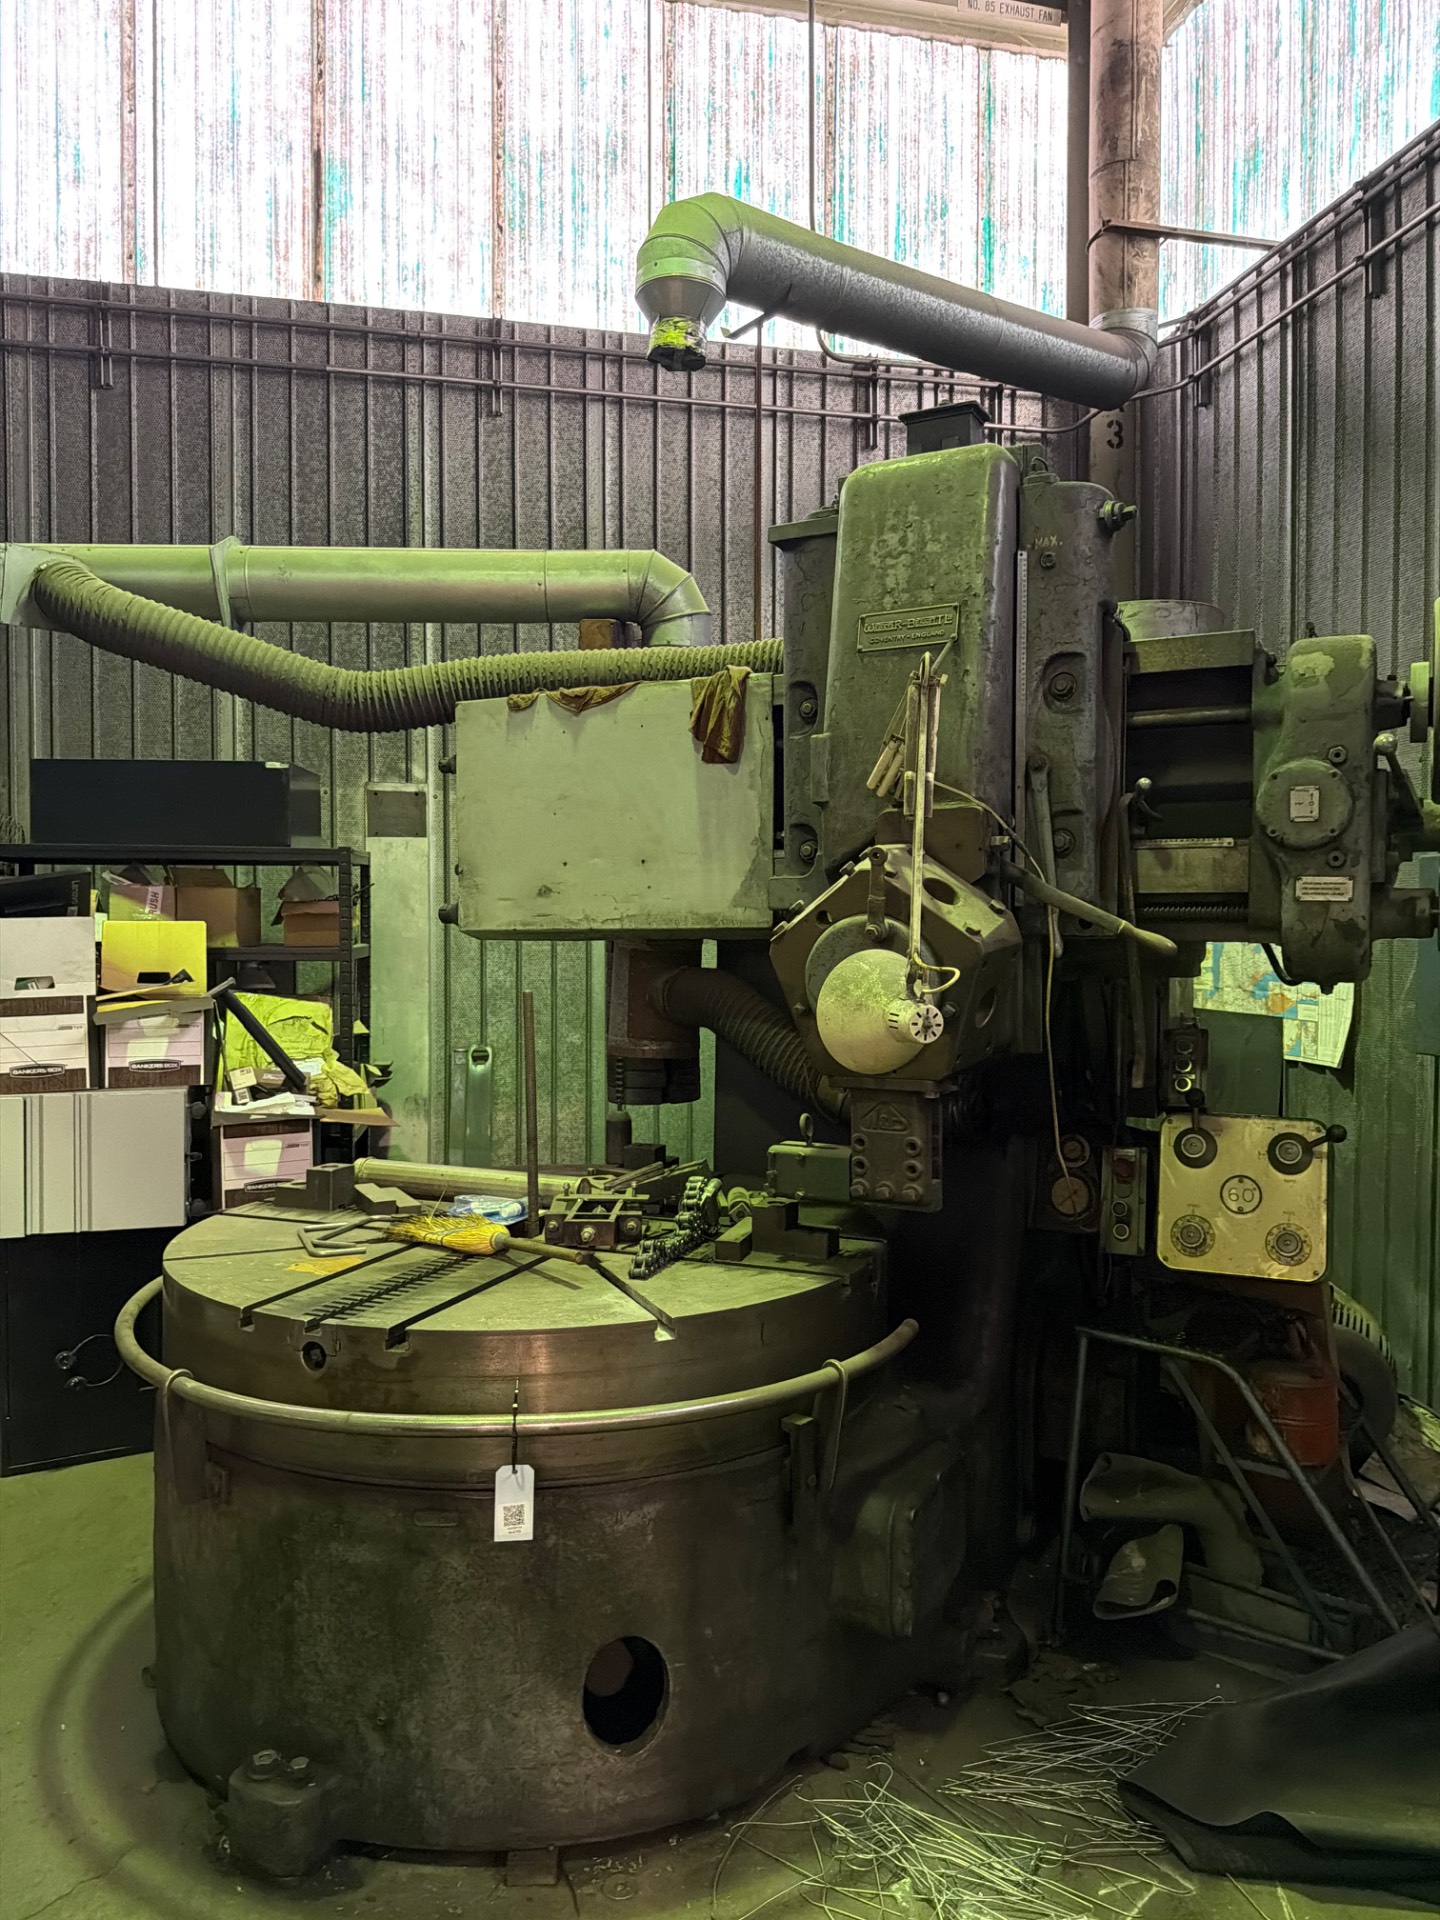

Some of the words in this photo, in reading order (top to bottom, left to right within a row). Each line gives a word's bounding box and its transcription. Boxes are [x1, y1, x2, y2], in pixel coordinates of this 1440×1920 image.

[967, 0, 981, 11] NO.
[985, 1, 996, 13] 85
[999, 2, 1034, 18] EXHAUST
[1038, 9, 1053, 21] FAN
[1106, 419, 1124, 449] 3
[12, 1066, 47, 1076] BANKERS
